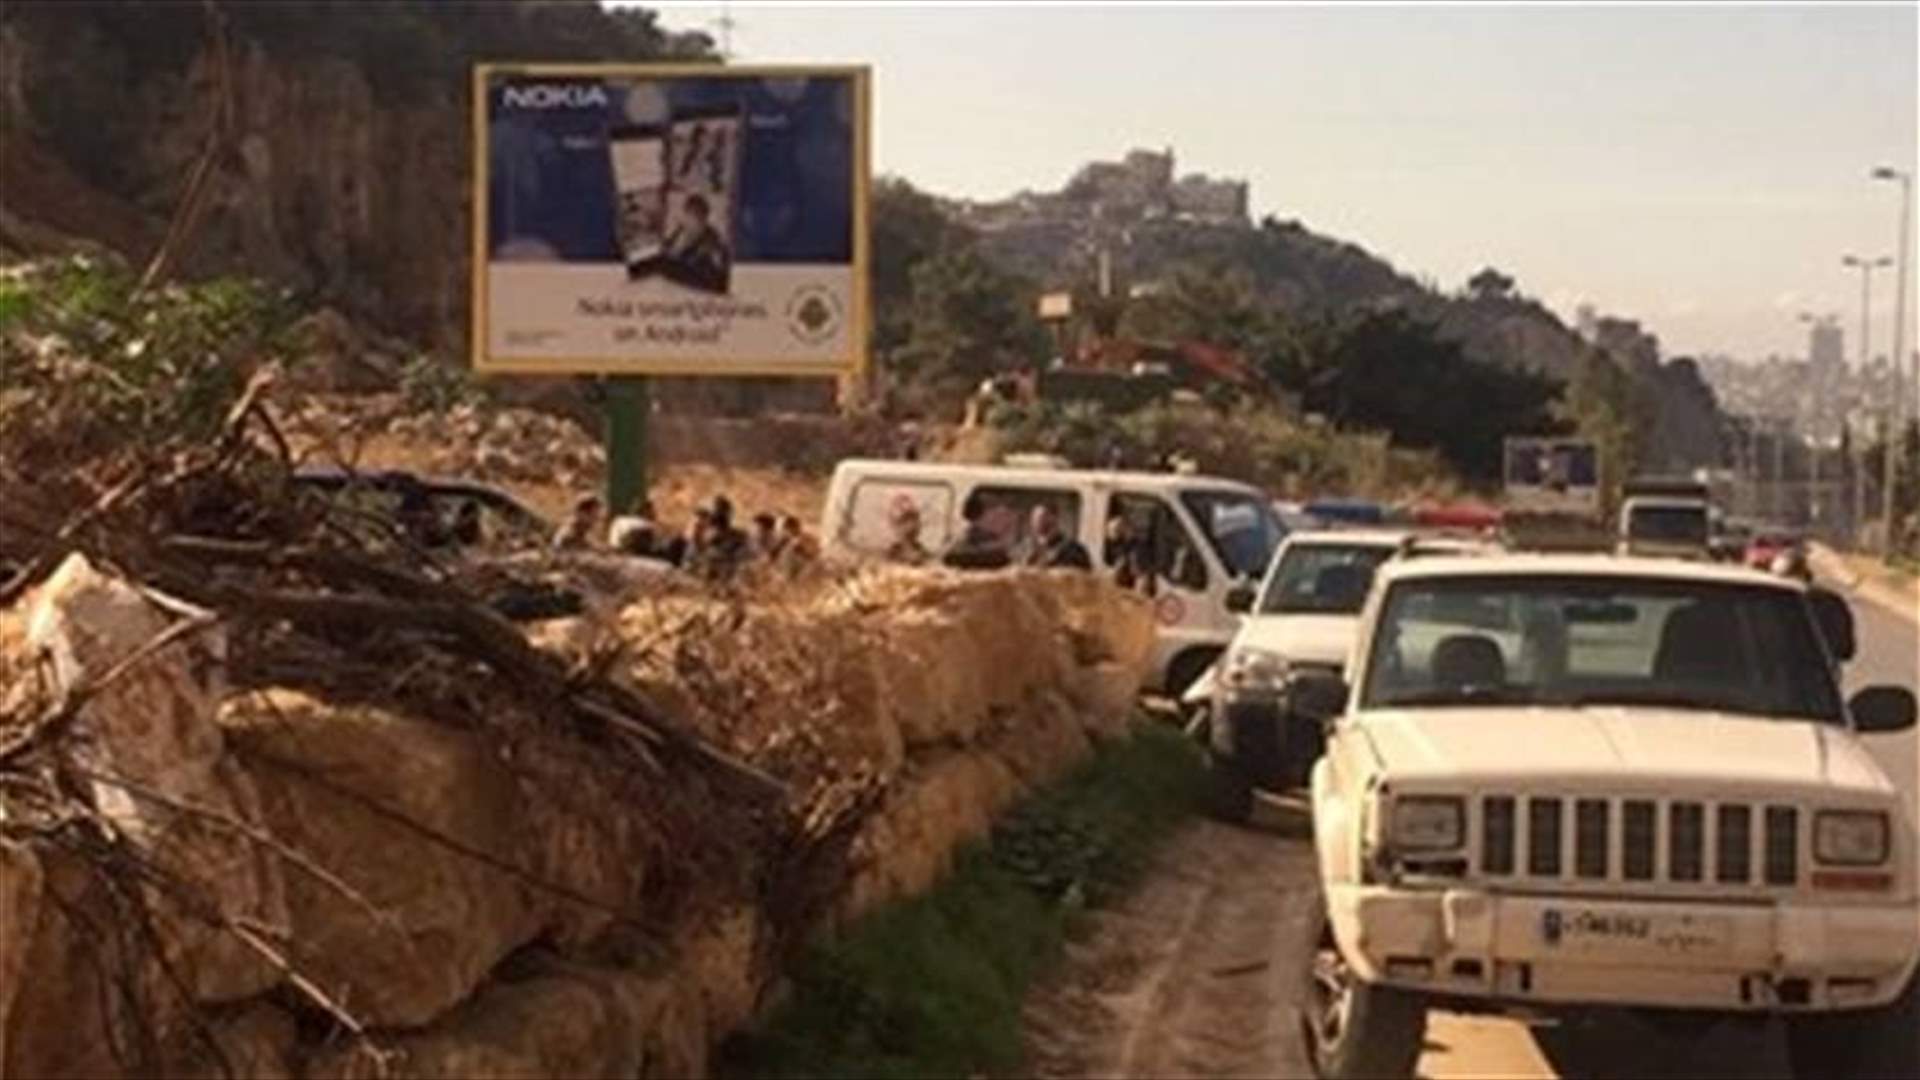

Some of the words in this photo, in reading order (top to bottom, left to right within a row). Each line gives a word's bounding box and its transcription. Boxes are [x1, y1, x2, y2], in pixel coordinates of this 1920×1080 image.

[503, 84, 608, 107] NOKIA
[576, 297, 633, 317] Nokia
[638, 300, 769, 323] smartphones
